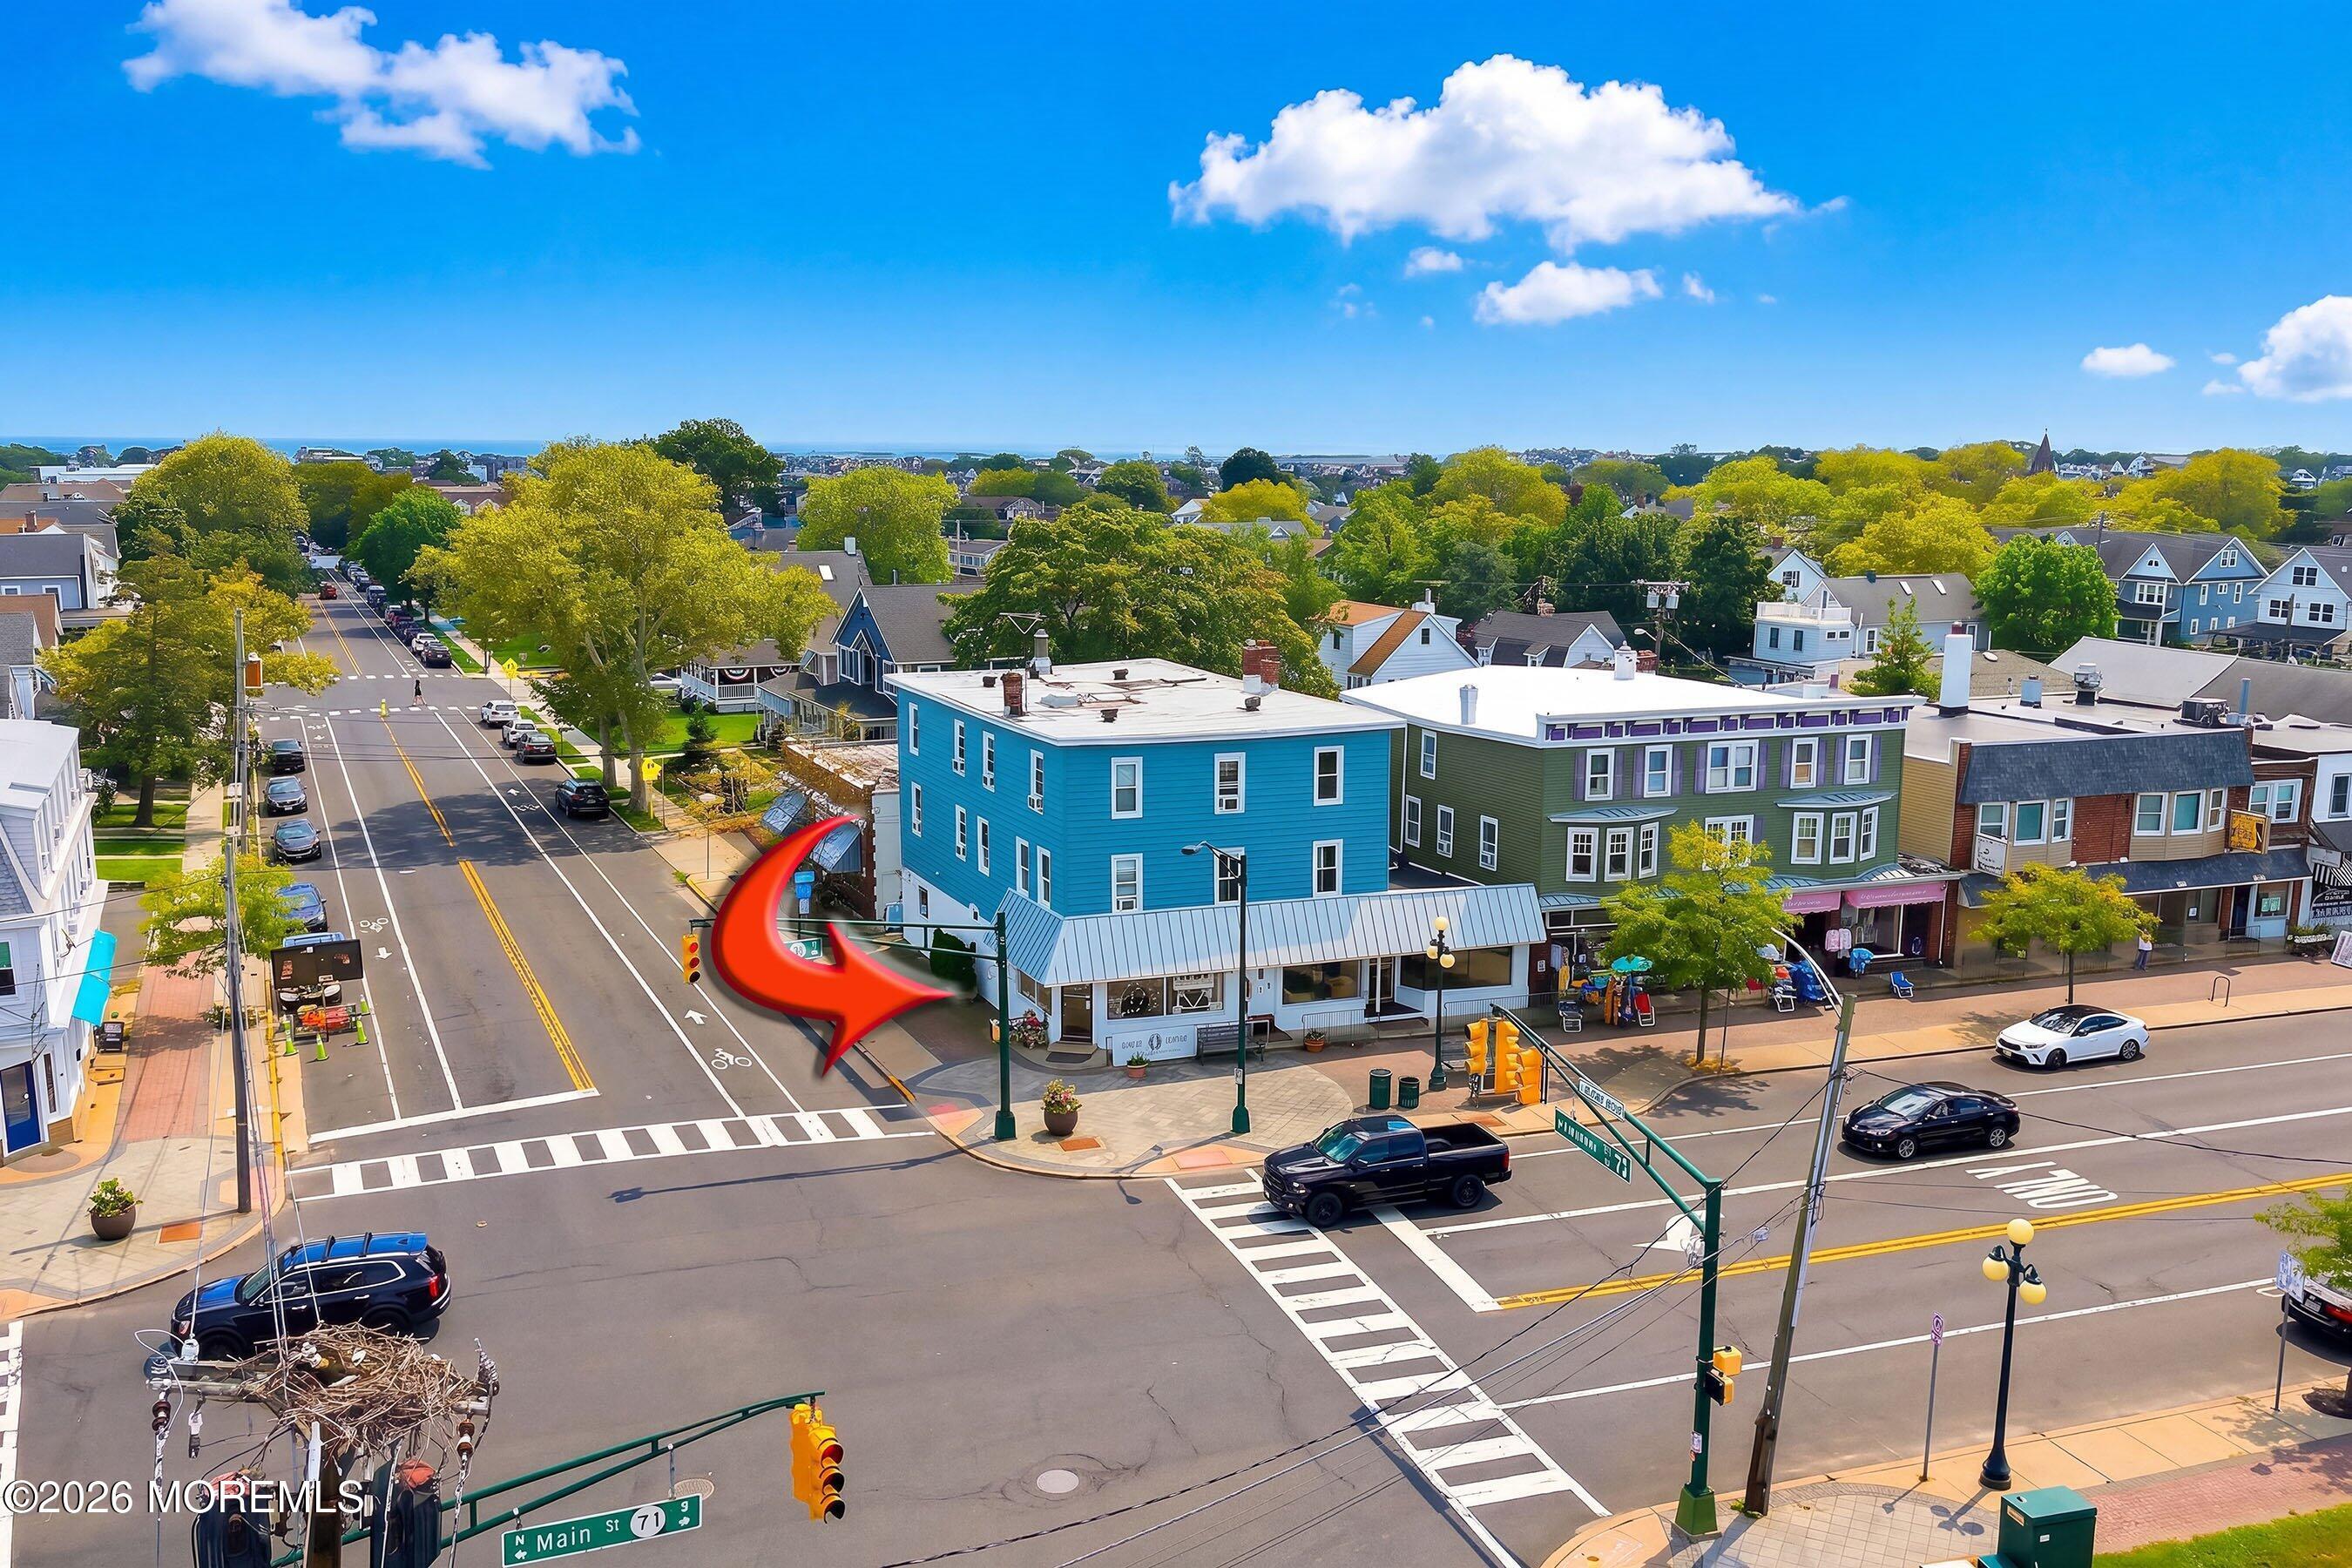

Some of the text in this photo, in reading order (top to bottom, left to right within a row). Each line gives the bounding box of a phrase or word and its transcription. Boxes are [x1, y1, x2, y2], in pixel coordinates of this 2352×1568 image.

[1965, 1161, 2119, 1209] ONLY
[516, 1535, 525, 1546] N
[537, 1526, 591, 1552] Main
[605, 1518, 619, 1533] St
[637, 1511, 660, 1531] 71
